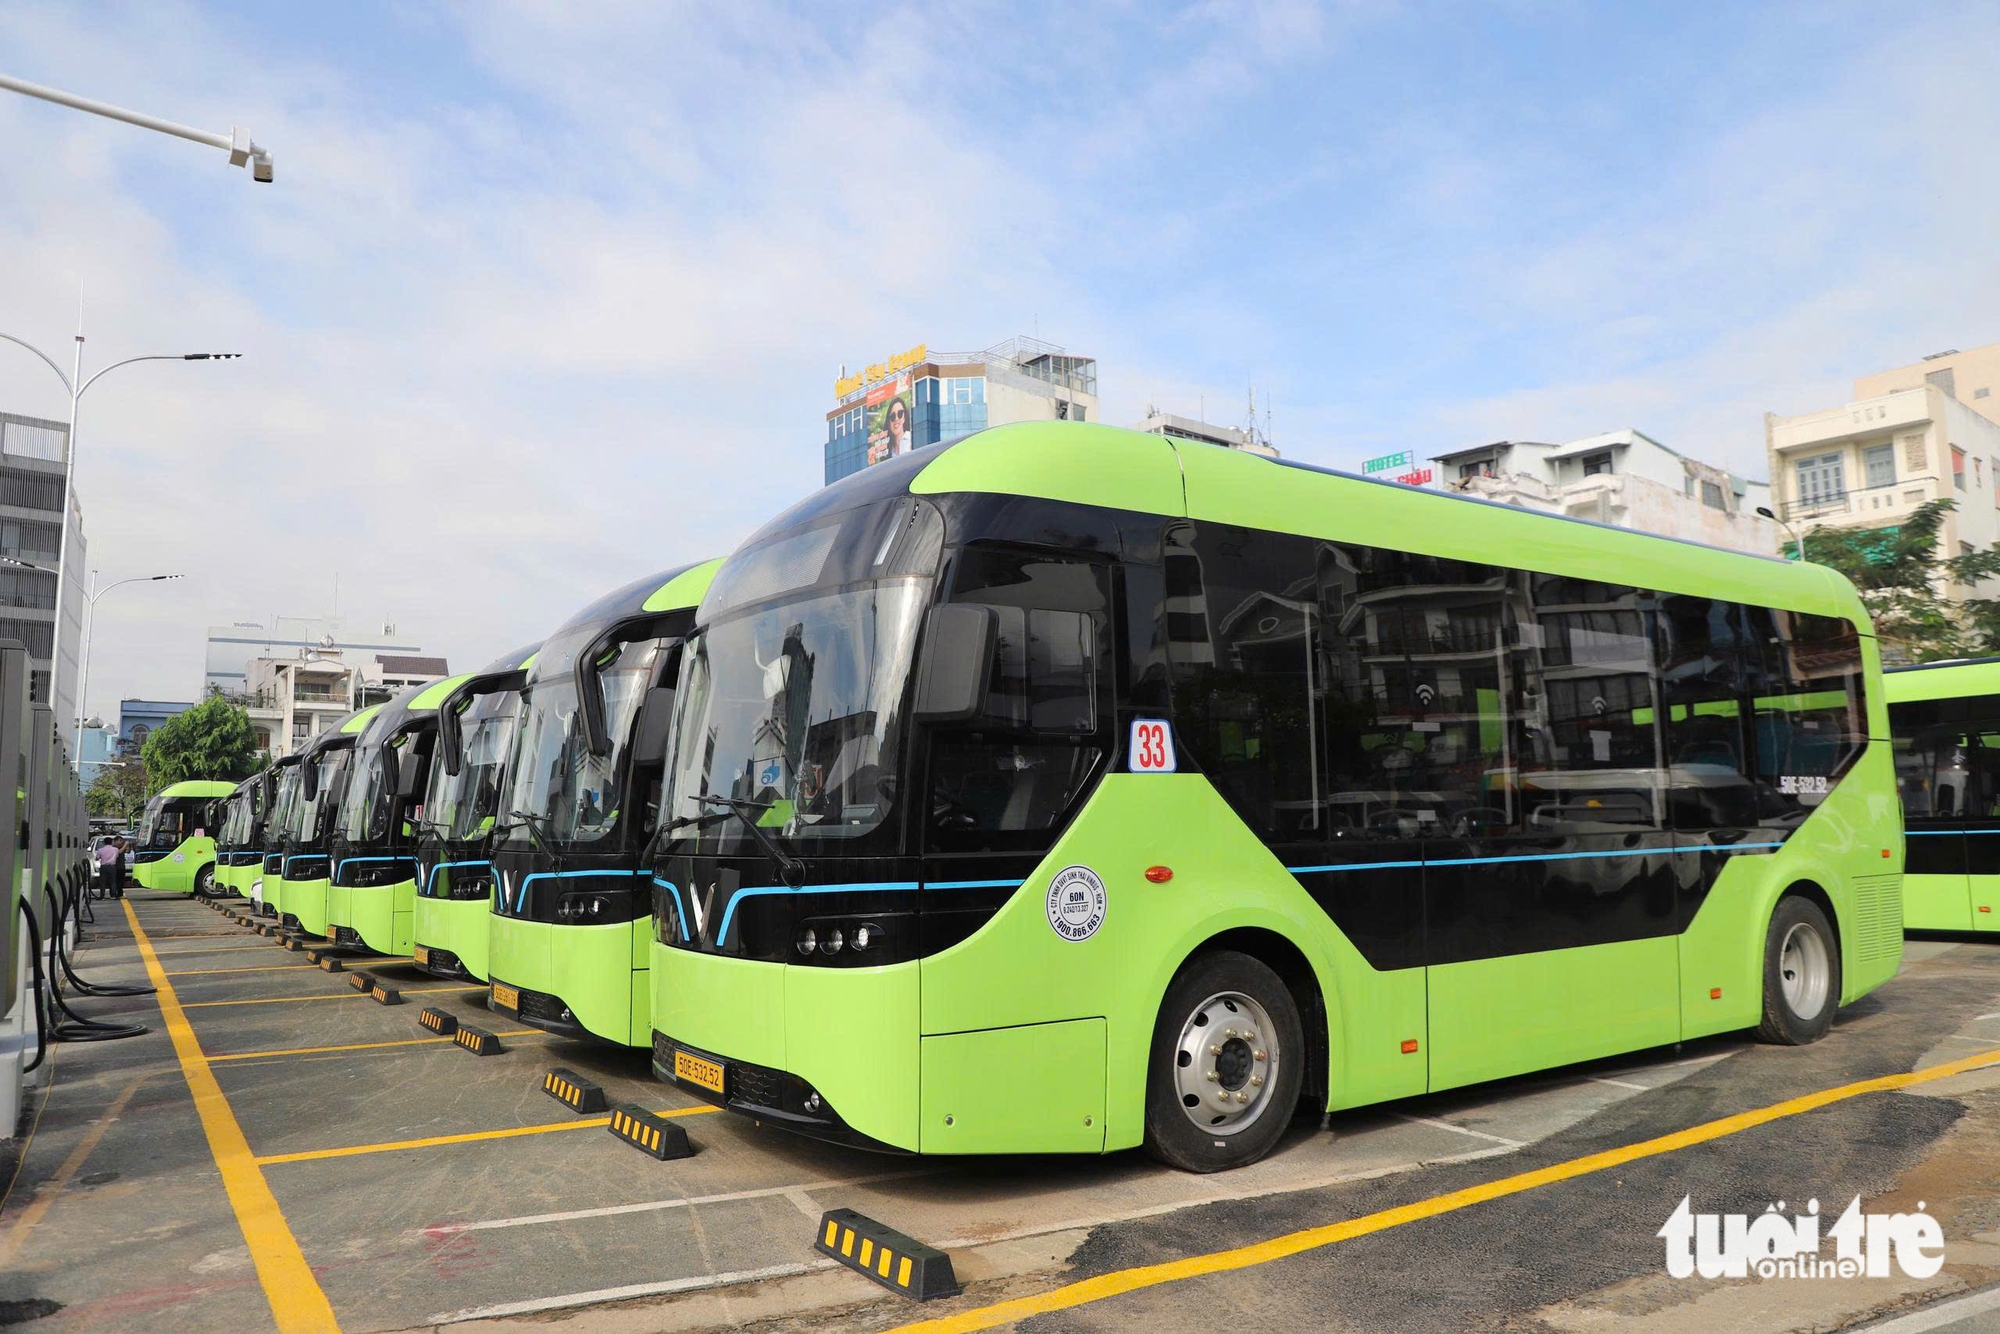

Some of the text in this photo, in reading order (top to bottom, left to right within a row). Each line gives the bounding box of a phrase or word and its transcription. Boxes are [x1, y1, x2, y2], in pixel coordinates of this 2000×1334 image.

[1366, 453, 1407, 473] HOTEL
[1138, 724, 1166, 768] 33
[1779, 776, 1828, 794] 50E-532.52
[1070, 892, 1084, 902] 60N
[1054, 914, 1100, 937] 1900.866.663
[678, 1056, 720, 1087] 50E-532.52
